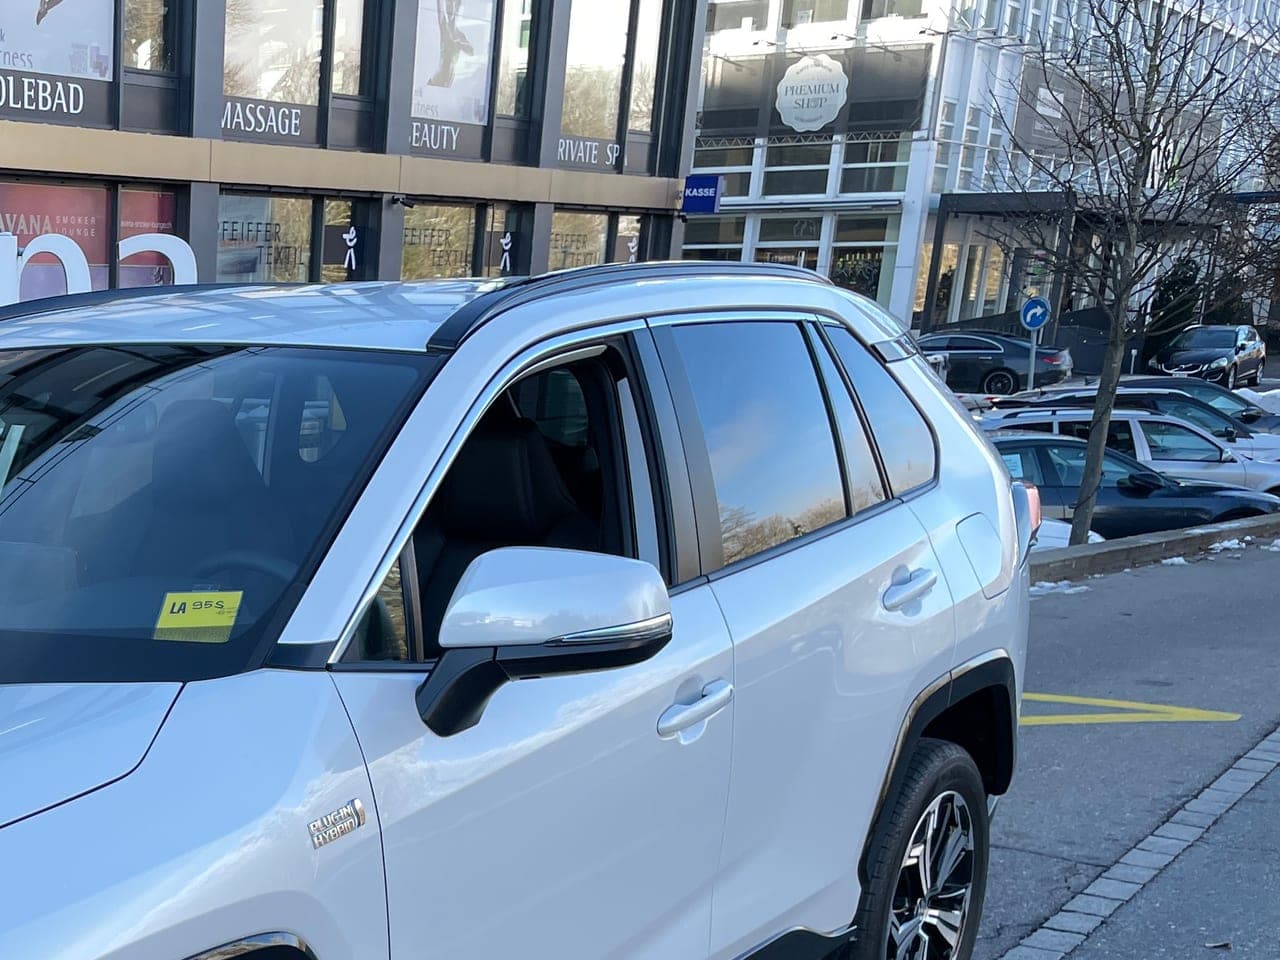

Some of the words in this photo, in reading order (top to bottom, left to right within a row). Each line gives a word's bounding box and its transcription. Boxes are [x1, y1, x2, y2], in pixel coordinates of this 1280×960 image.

[784, 83, 839, 96] PREMIUM
[409, 122, 461, 151] EAUTY
[605, 143, 628, 166] SP
[685, 187, 716, 197] KASSE
[55, 215, 97, 225] SMOKER
[217, 220, 282, 243] FEIFFER
[169, 601, 187, 615] LA
[309, 804, 353, 835] PLUG-IN
[313, 817, 356, 848] HYBRID
